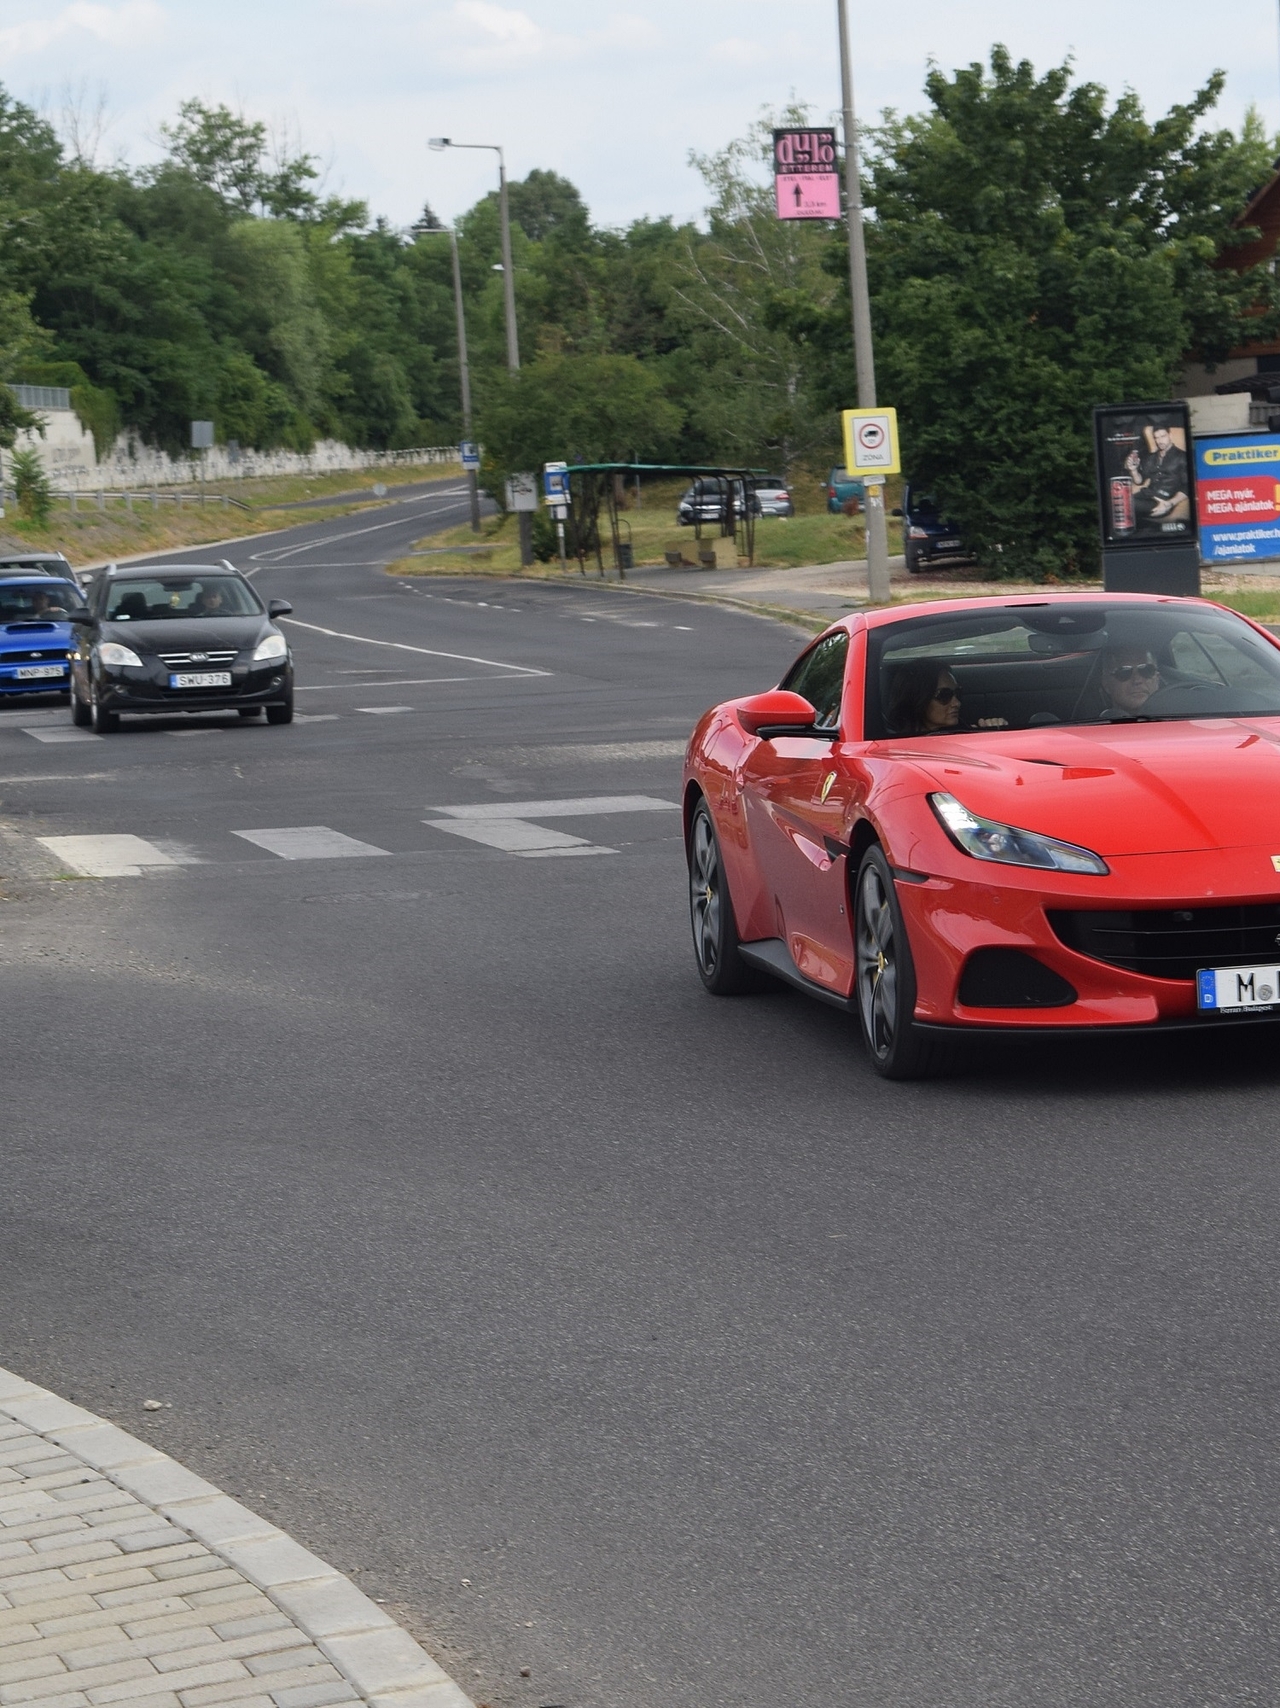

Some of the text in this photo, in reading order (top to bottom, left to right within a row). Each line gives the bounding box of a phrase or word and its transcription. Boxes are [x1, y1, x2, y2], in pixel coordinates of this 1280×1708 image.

[1212, 449, 1278, 461] Praktiker
[1206, 490, 1233, 501] MEGA
[1207, 503, 1233, 514] MEGA
[20, 667, 61, 677] MNP-975
[180, 674, 229, 686] SWU-376
[1237, 972, 1255, 1002] M
[1204, 994, 1213, 1003] D
